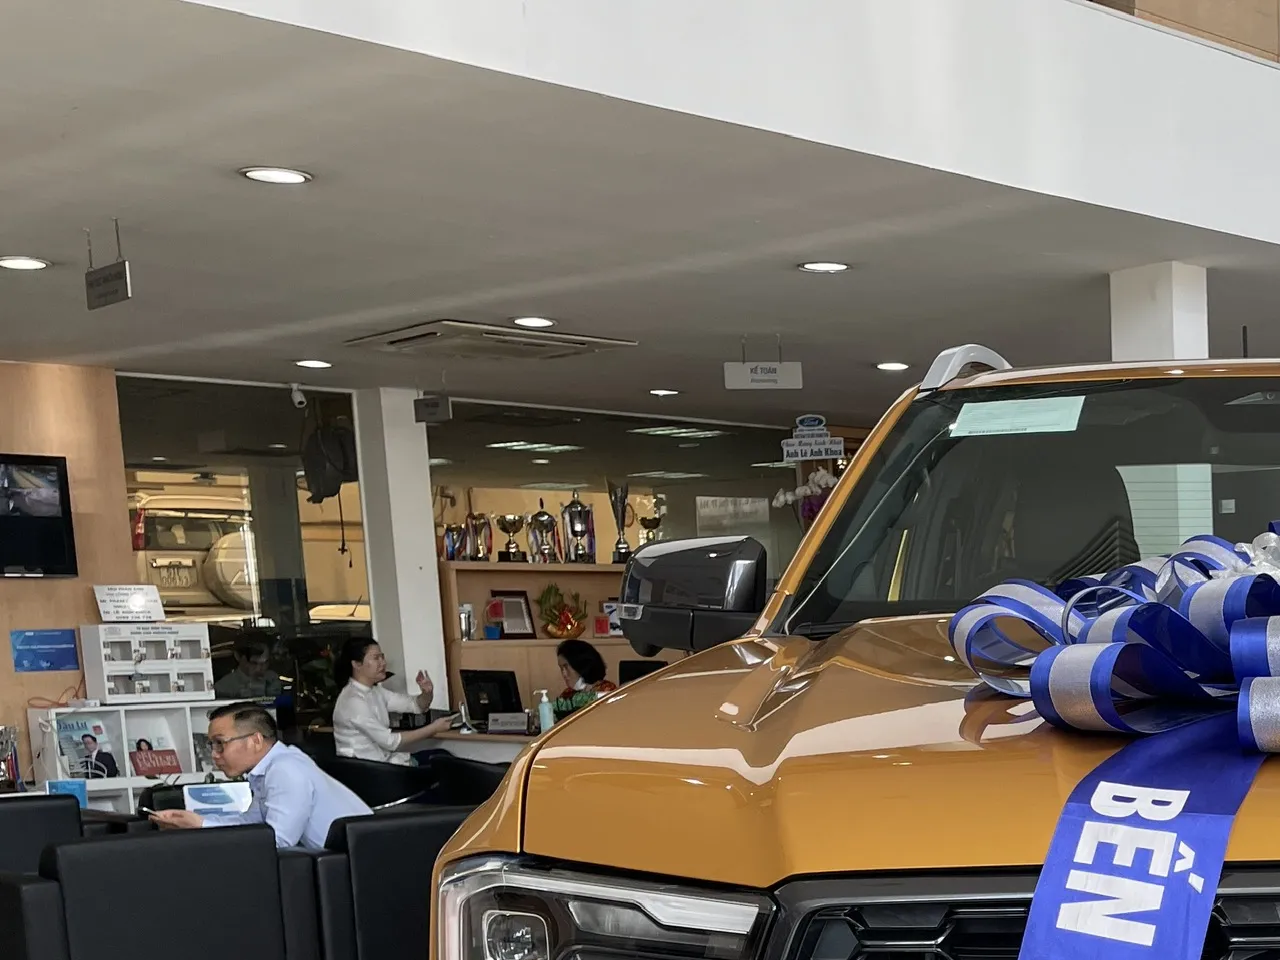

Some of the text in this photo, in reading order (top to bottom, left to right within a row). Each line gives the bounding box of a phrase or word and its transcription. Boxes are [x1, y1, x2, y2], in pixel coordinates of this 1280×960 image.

[786, 448, 799, 458] Anh
[810, 447, 823, 457] Anh
[824, 446, 842, 456] Khoa
[1056, 781, 1204, 947] BẾN
